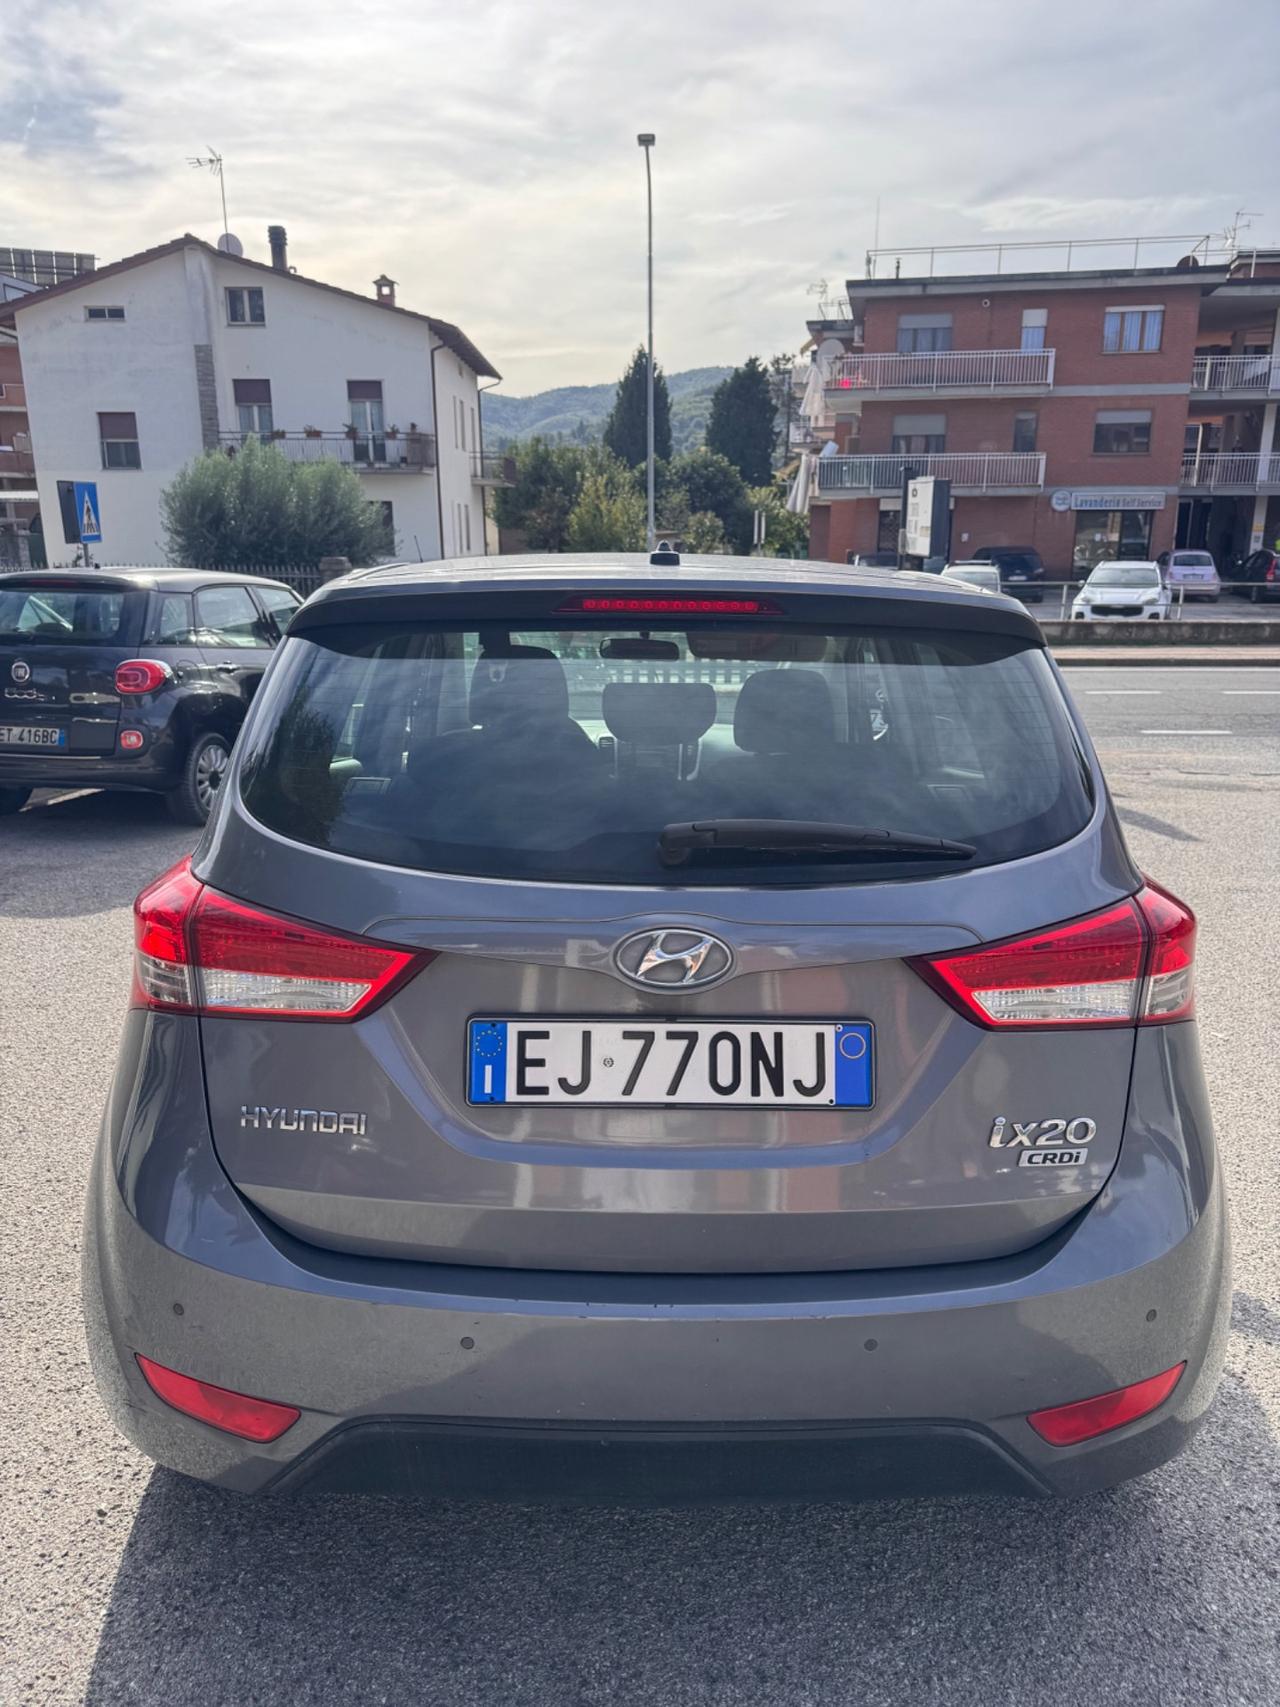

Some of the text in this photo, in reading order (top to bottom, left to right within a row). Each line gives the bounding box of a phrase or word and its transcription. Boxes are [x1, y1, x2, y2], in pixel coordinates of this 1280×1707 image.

[18, 728, 58, 744] 416BC
[516, 1030, 826, 1098] EJ 770NJ
[240, 1105, 367, 1136] HYUNDAI
[988, 1115, 1097, 1149] ix20
[1027, 1151, 1081, 1165] CRDi
